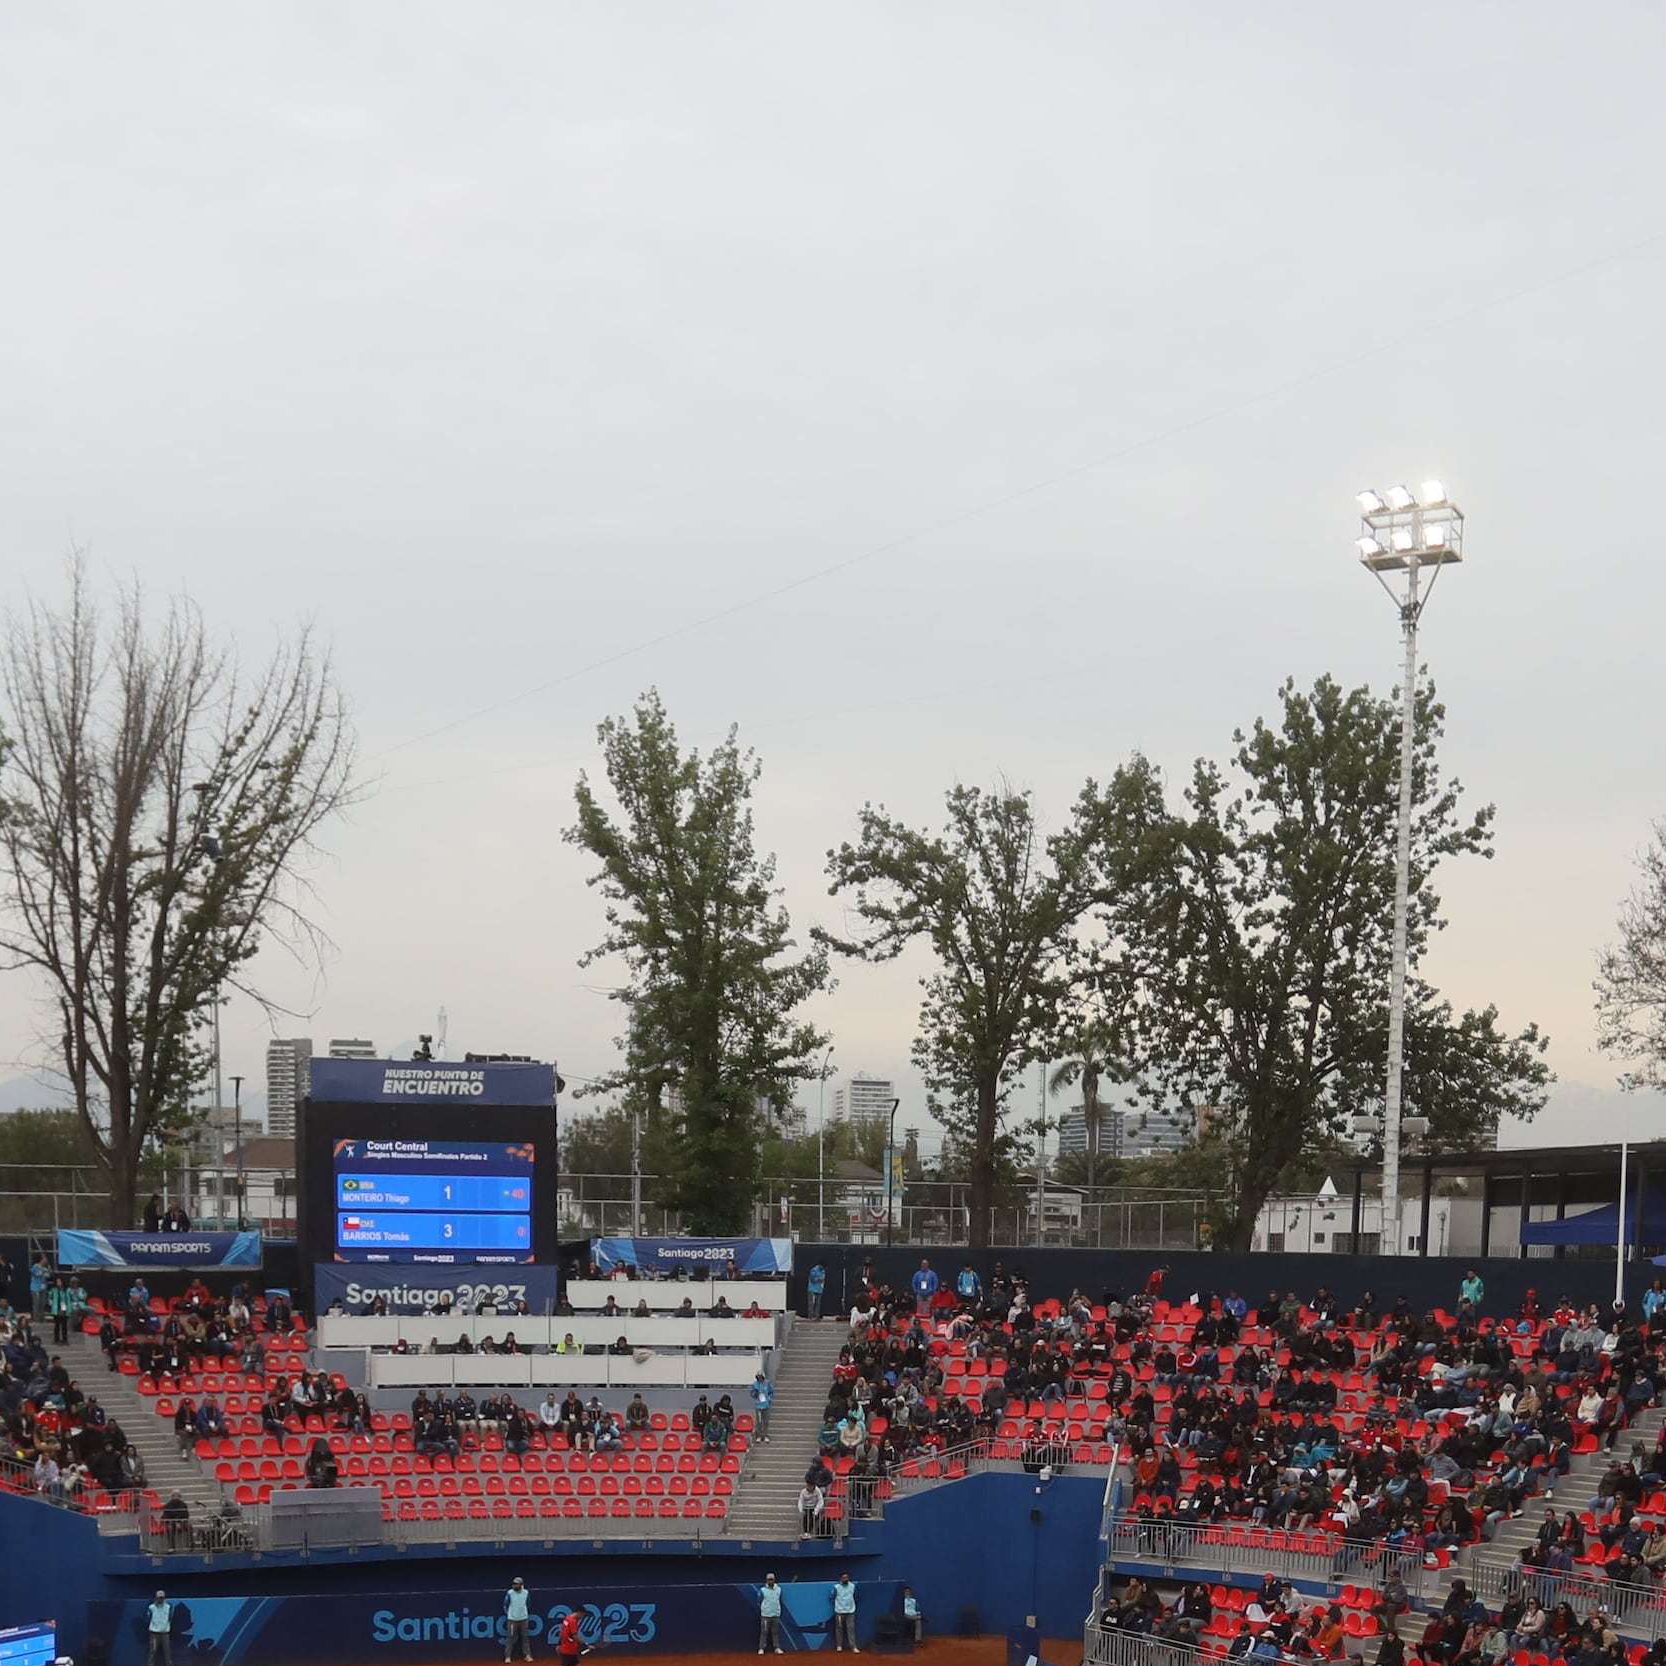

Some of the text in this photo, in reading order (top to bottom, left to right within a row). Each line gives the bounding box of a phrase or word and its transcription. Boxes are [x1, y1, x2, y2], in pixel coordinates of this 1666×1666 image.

[385, 1069, 485, 1081] NUESTRO PUNTO DE
[382, 1080, 484, 1096] ENCUENTRO
[366, 1140, 428, 1152] Court Central
[342, 1192, 410, 1204] MONTEIRO Thiago
[444, 1185, 452, 1200] 1
[343, 1231, 410, 1241] BARRIOS Tomás
[444, 1224, 453, 1238] 3
[130, 1242, 211, 1254] PANAM SPORTS
[658, 1248, 735, 1260] Santiago 2023
[346, 1283, 526, 1309] Santiago 2023
[372, 1603, 656, 1644] Santiago 2023
